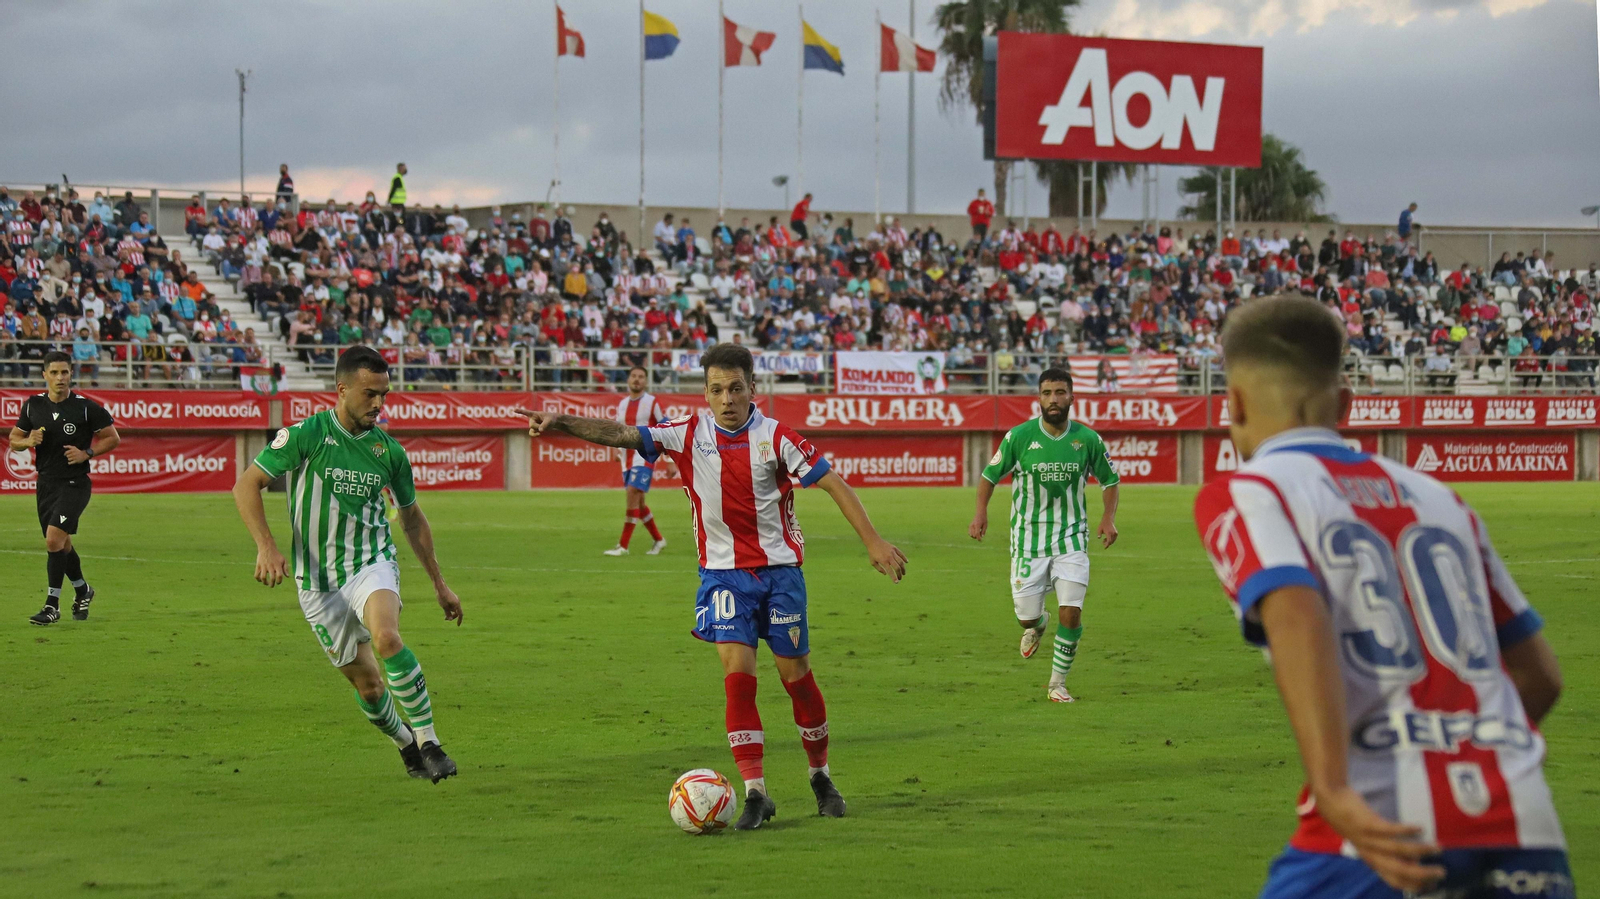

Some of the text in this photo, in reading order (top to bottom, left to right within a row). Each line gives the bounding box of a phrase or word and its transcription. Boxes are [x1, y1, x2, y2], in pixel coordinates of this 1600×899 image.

[1038, 47, 1225, 151] AON
[841, 367, 915, 386] KOMANDO
[103, 400, 173, 418] MUÑOZ
[184, 402, 261, 418] PODOLOGÍA
[384, 401, 447, 419] MUÑOZ
[1349, 408, 1401, 420] APOLO
[1423, 408, 1474, 420] APOLO
[1485, 408, 1536, 420] APOLO
[1546, 408, 1597, 420] APOLO
[539, 444, 611, 466] Hospital
[1444, 442, 1569, 455] Materiales de Construcción
[90, 453, 227, 474] zalema Motor
[1032, 462, 1080, 473] FOREVER
[1443, 455, 1569, 472] AGUA MARINA
[325, 467, 381, 487] FOREVER
[412, 465, 482, 485] Algeciras
[1040, 472, 1072, 482] GREEN
[1, 479, 37, 490] ŠKOD
[333, 481, 372, 498] GREEN
[1015, 557, 1033, 578] 15
[711, 589, 736, 622] 10
[1319, 519, 1501, 684] 30
[314, 623, 334, 647] 8
